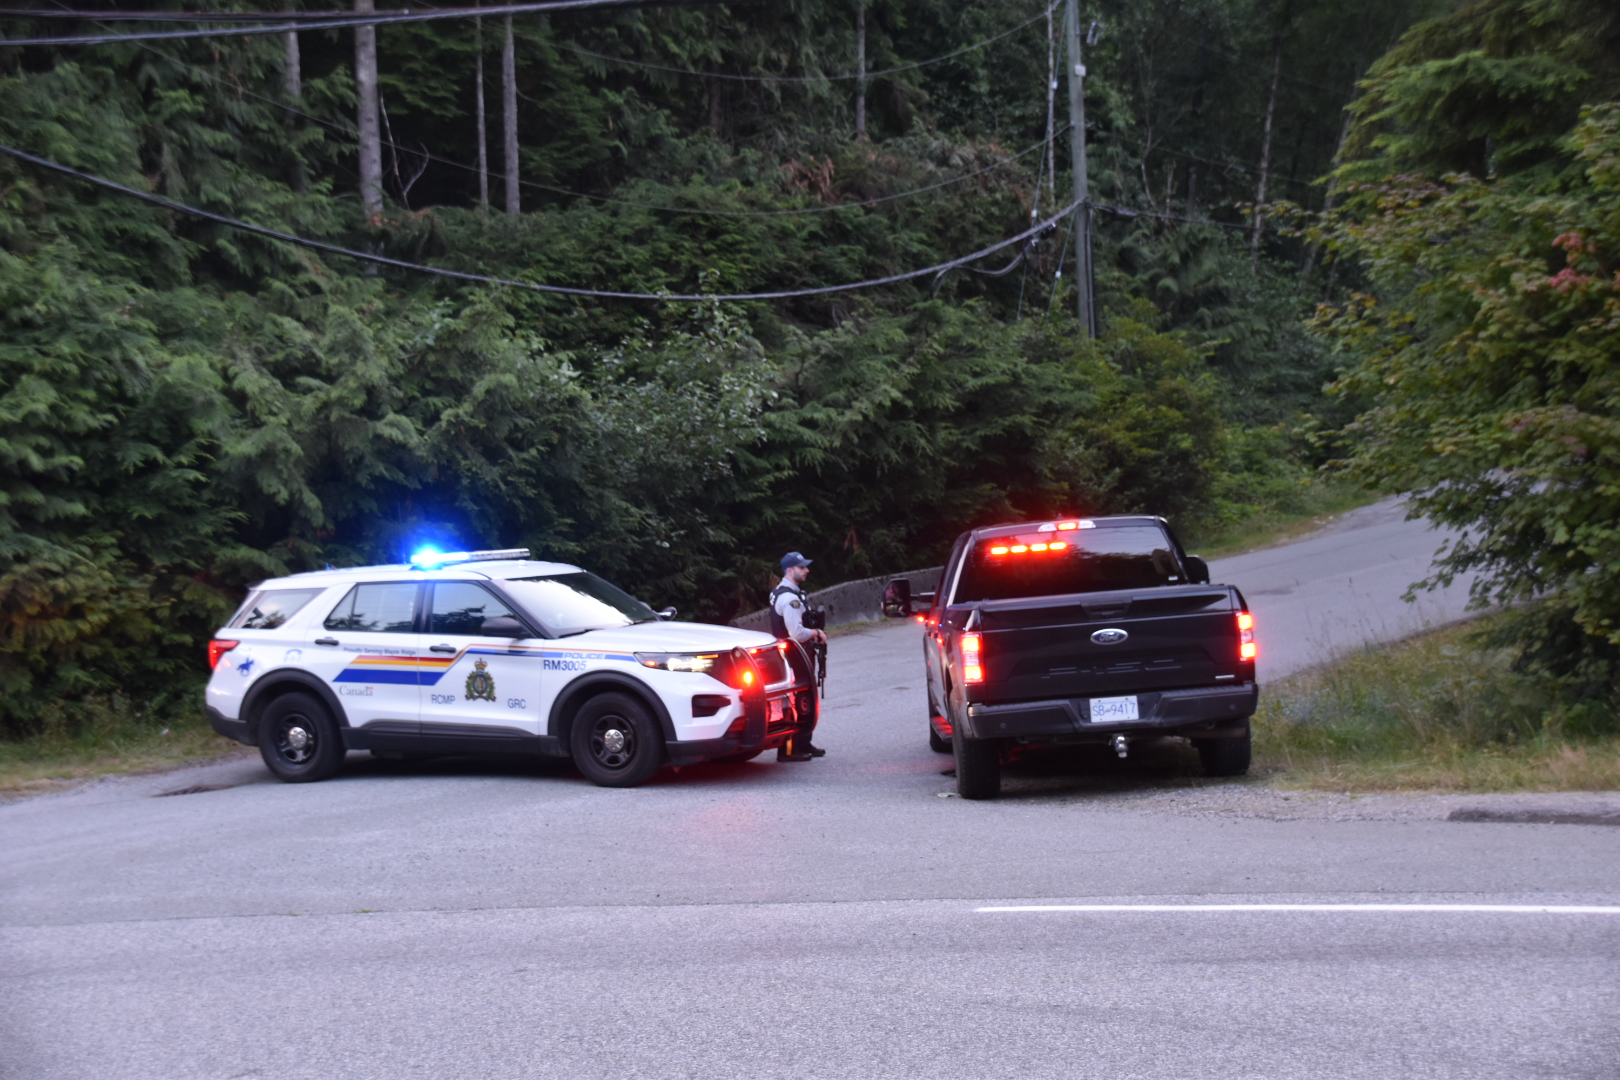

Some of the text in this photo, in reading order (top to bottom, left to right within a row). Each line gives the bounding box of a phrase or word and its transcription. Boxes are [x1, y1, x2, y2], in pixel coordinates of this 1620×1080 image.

[1099, 631, 1120, 642] Ford
[401, 649, 417, 657] Ridge
[564, 652, 606, 660] POLICE
[543, 659, 587, 671] RM3005
[339, 685, 374, 697] Canada
[431, 694, 456, 705] RCMP
[507, 698, 527, 709] GRC
